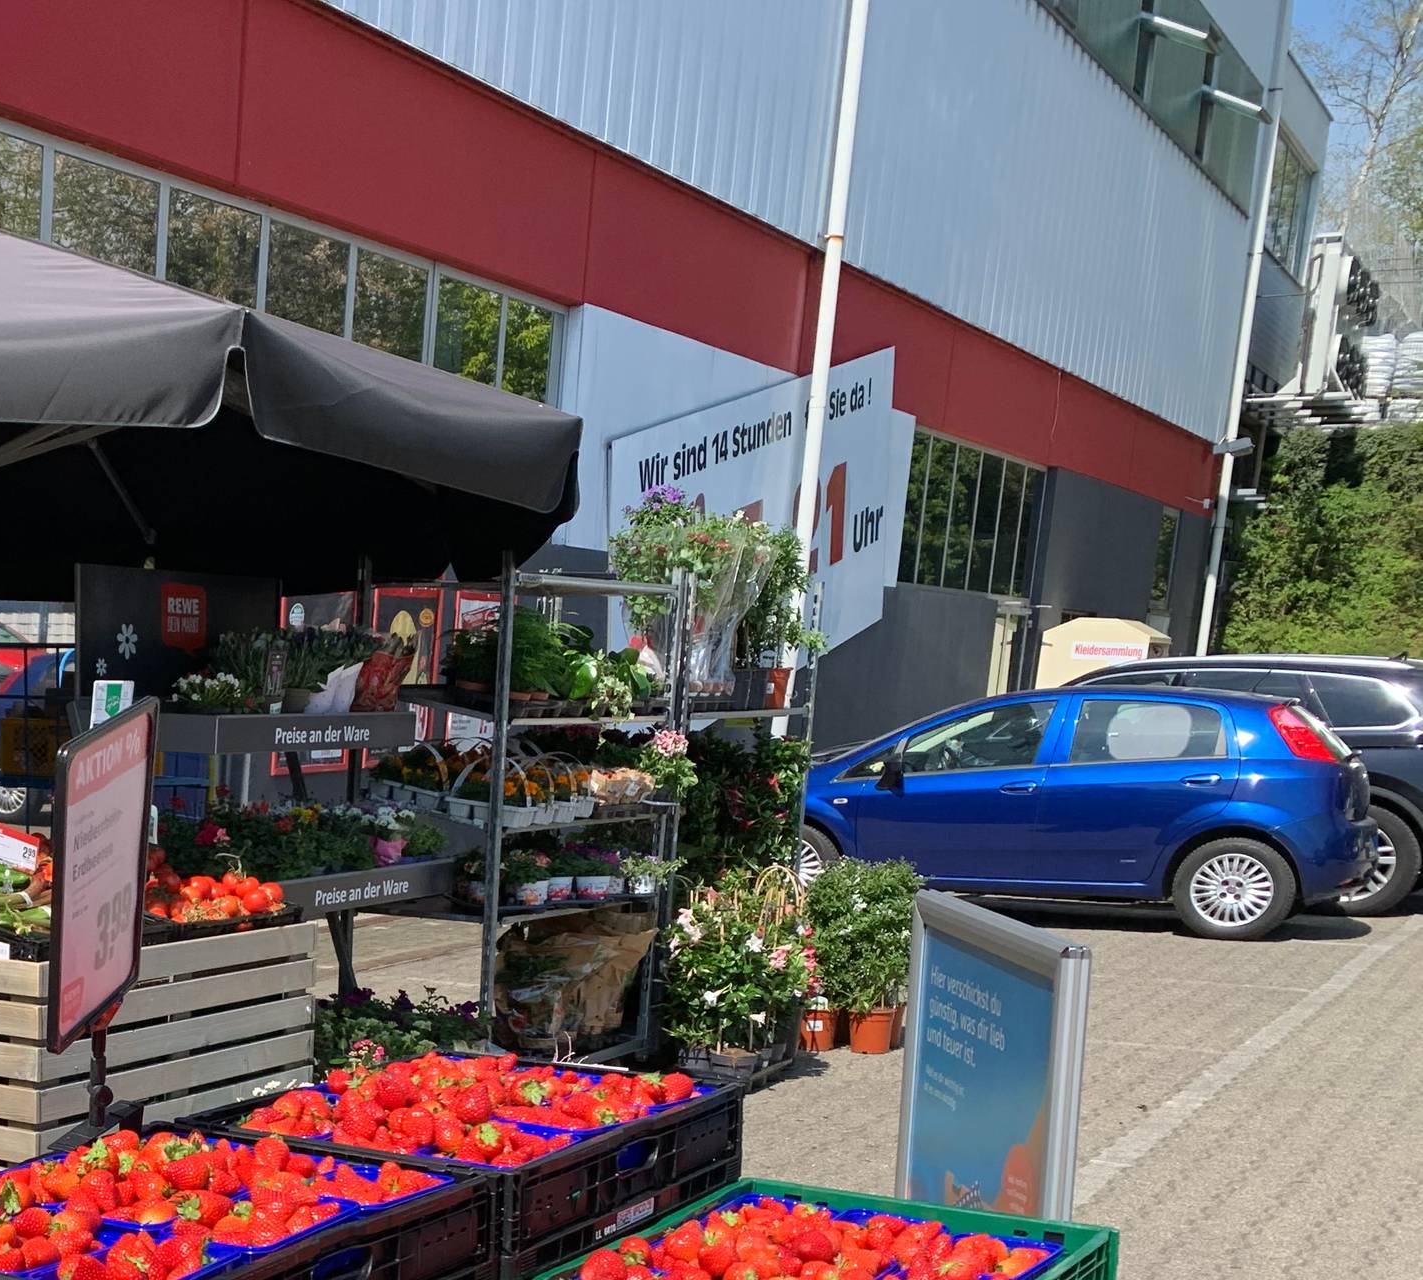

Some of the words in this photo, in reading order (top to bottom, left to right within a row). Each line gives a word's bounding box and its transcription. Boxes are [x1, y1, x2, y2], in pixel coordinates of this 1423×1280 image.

[829, 387, 846, 420] Sie
[850, 381, 865, 413] da
[639, 452, 668, 492] Wir
[673, 436, 707, 480] sind
[712, 430, 728, 464] 14
[732, 411, 792, 457] Stunden
[852, 504, 884, 553] Uhr
[167, 597, 200, 615] REWE
[1074, 644, 1143, 661] Kleidersammlung
[274, 725, 307, 745] Preise
[309, 729, 322, 744] an
[324, 725, 342, 742] der
[344, 725, 370, 742] Ware
[75, 737, 124, 787] AKTION
[314, 886, 346, 907] Preise
[348, 887, 361, 901] an
[363, 881, 381, 900] der
[383, 879, 409, 897] Ware
[930, 964, 947, 989] Hier
[947, 975, 989, 1011] verschickst
[990, 992, 1002, 1017] du
[929, 995, 959, 1031] günstig,
[960, 1014, 976, 1036] was
[977, 1016, 988, 1041] dir
[990, 1023, 1005, 1051] lieb
[927, 1027, 942, 1047] und
[943, 1033, 964, 1059] teuer
[964, 1040, 976, 1068] ist.
